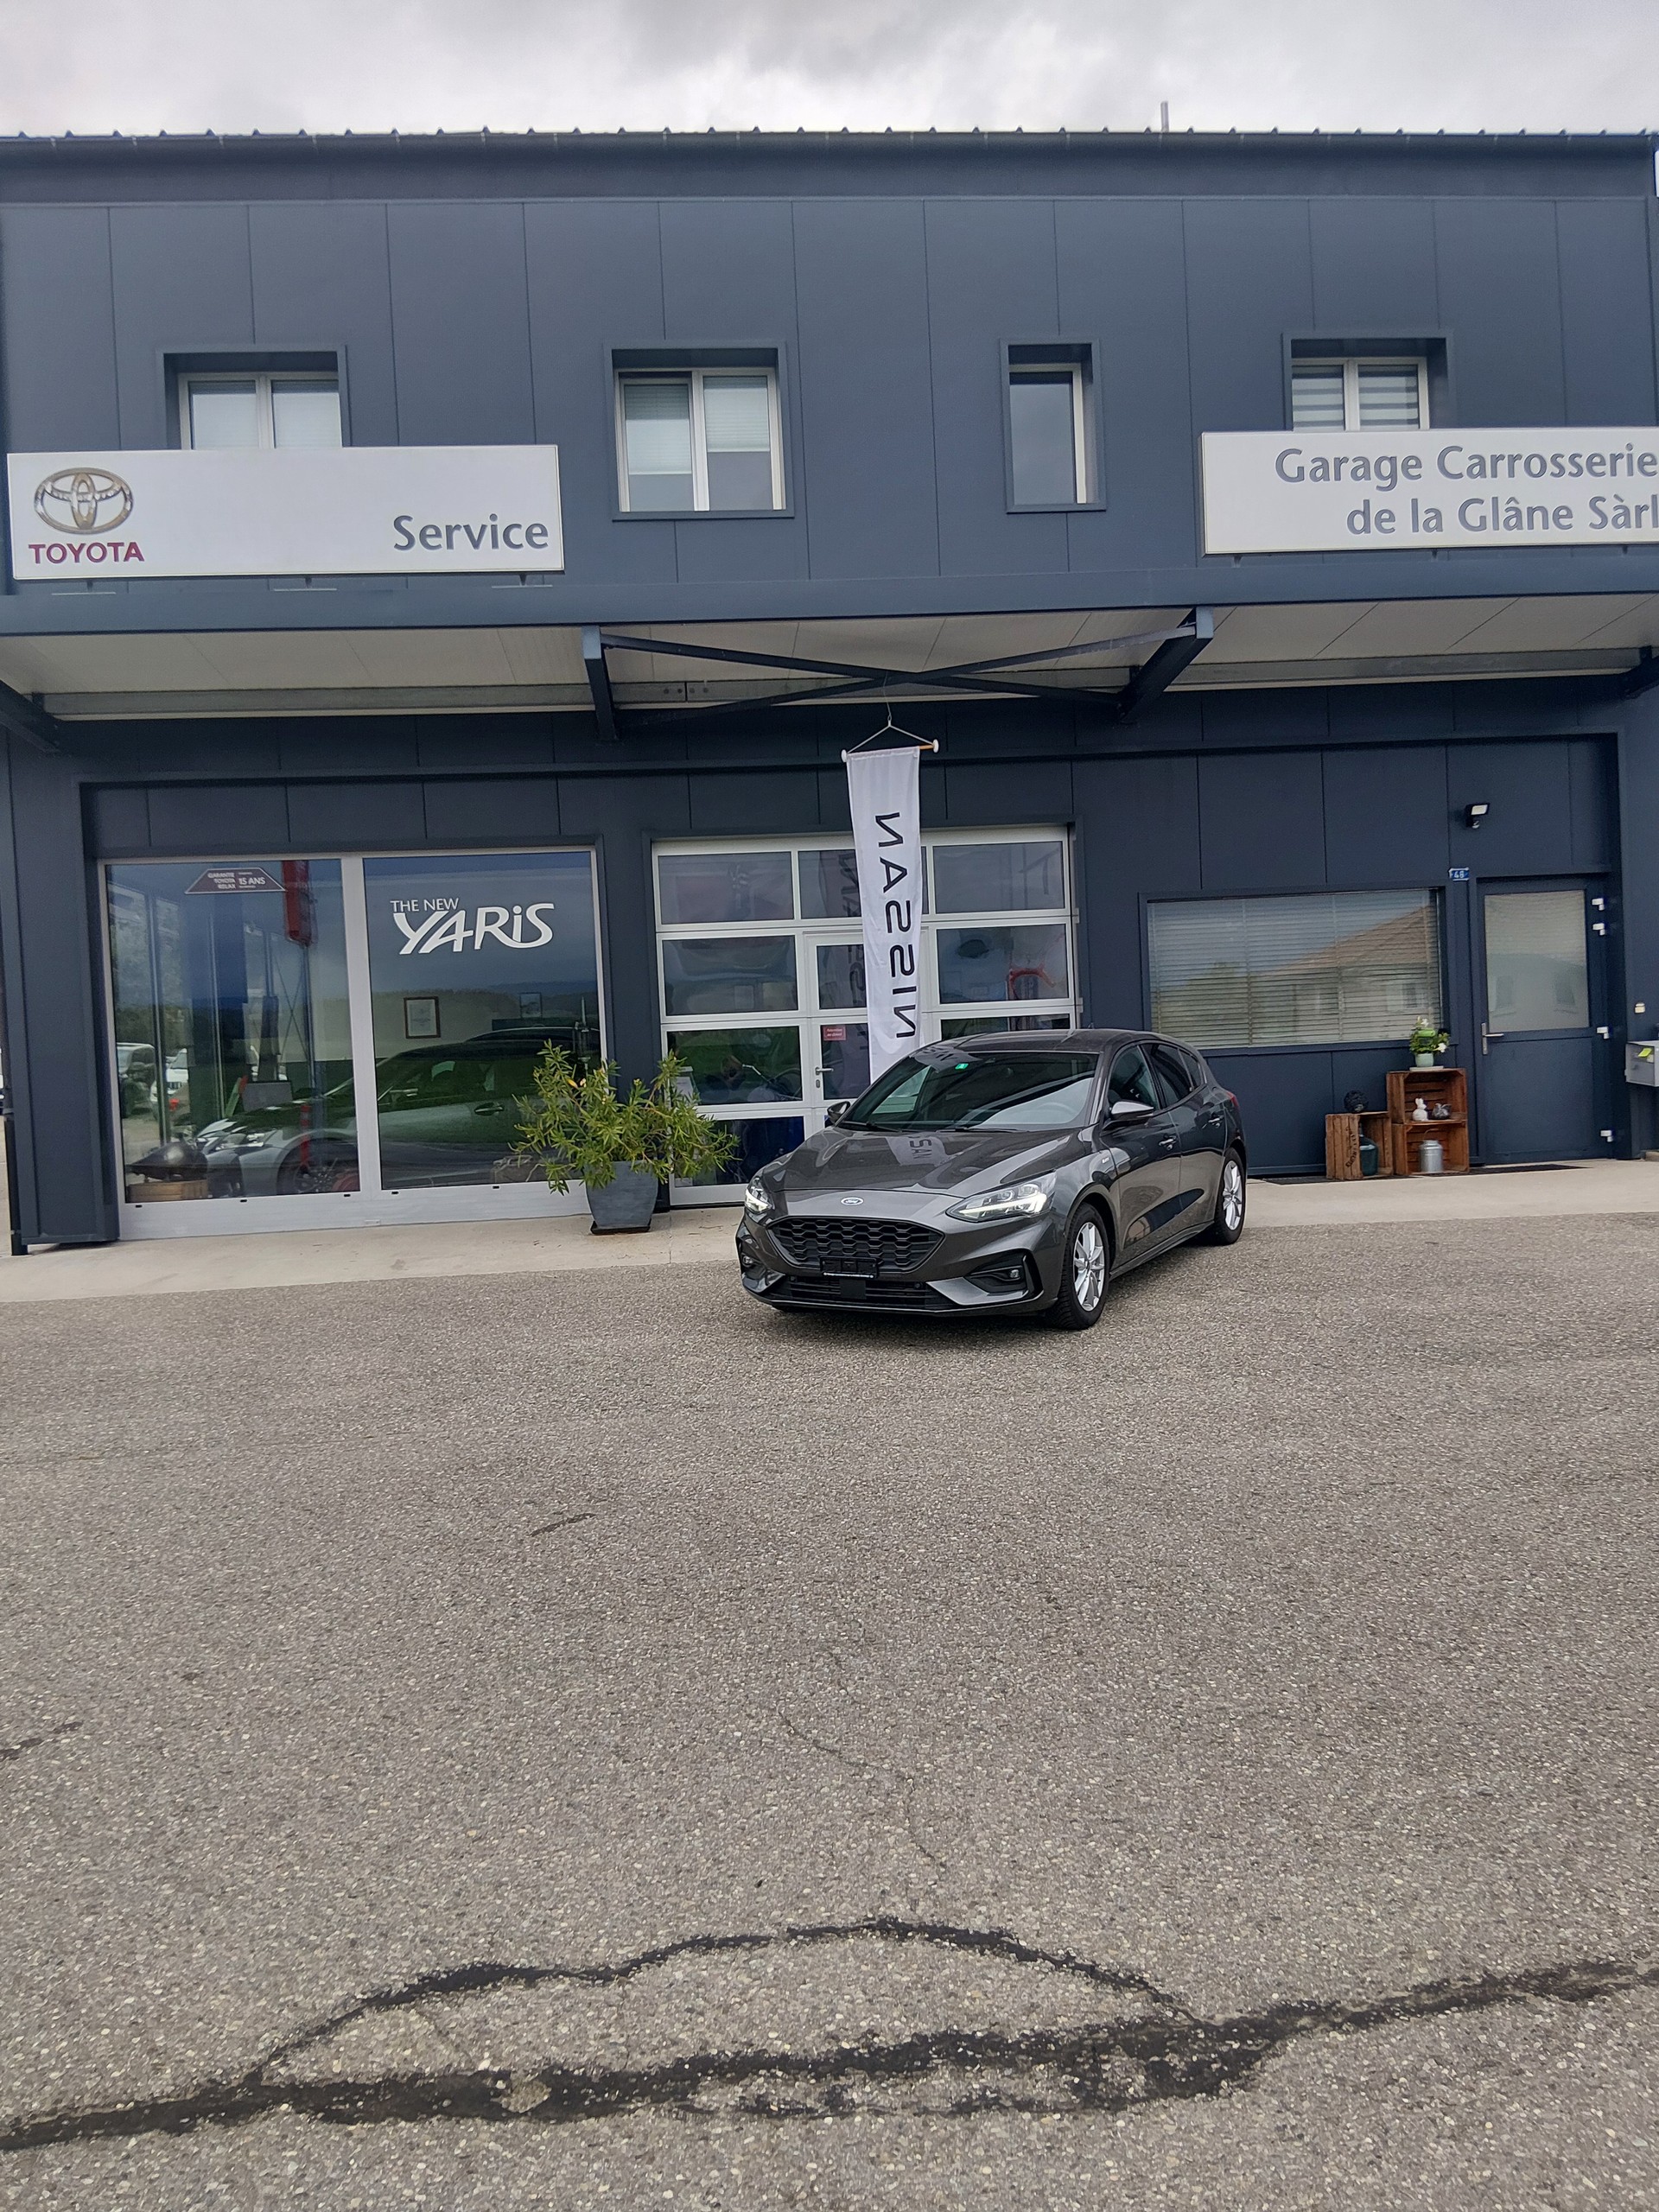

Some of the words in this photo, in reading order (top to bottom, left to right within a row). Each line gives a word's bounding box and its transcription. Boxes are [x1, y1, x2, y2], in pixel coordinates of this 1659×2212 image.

[1274, 448, 1422, 492] Garage
[1437, 442, 1657, 480] Carrosserie
[393, 513, 548, 552] Service
[1346, 499, 1395, 535] de
[1411, 498, 1443, 533] la
[1458, 497, 1573, 532] Glâne
[1588, 493, 1658, 530] Sàrl
[29, 542, 144, 564] TOYOTA
[391, 899, 420, 912] THE
[423, 897, 459, 911] NEW
